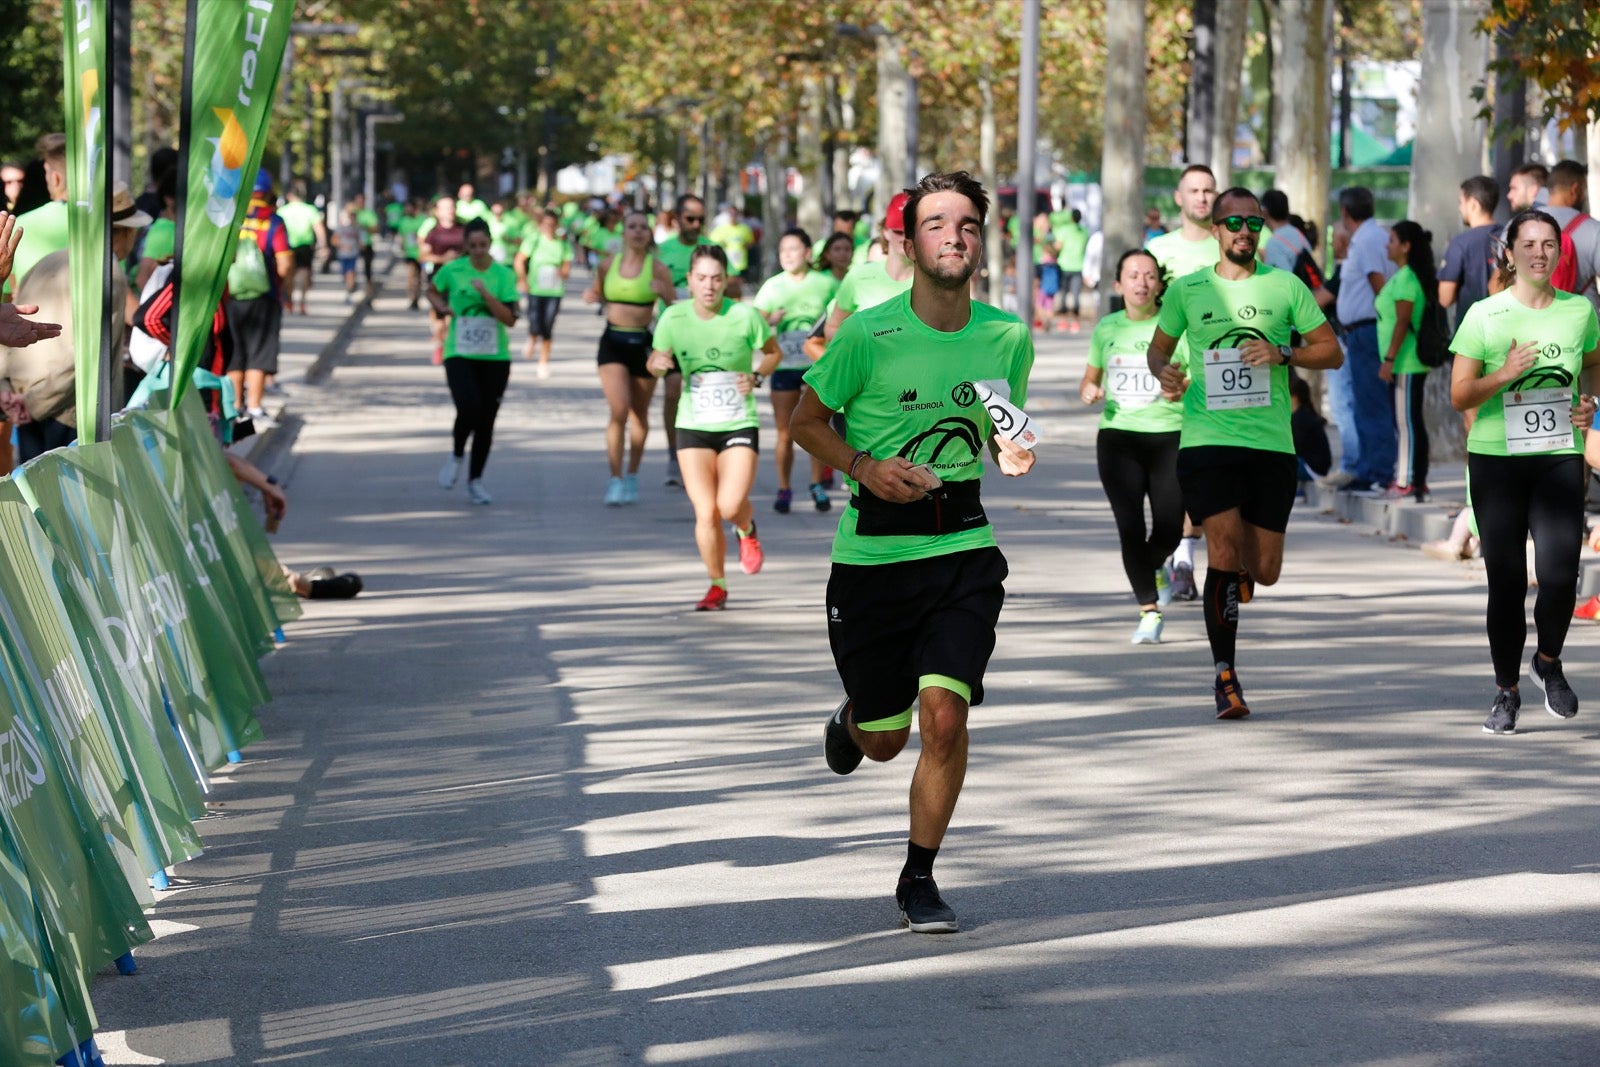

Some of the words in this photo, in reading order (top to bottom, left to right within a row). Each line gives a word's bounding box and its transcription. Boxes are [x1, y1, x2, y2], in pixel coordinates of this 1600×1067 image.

[1115, 372, 1155, 392] 210
[1221, 367, 1252, 391] 95
[699, 387, 737, 408] 582
[902, 400, 944, 411] IBERDROLA
[1524, 408, 1556, 433] 93
